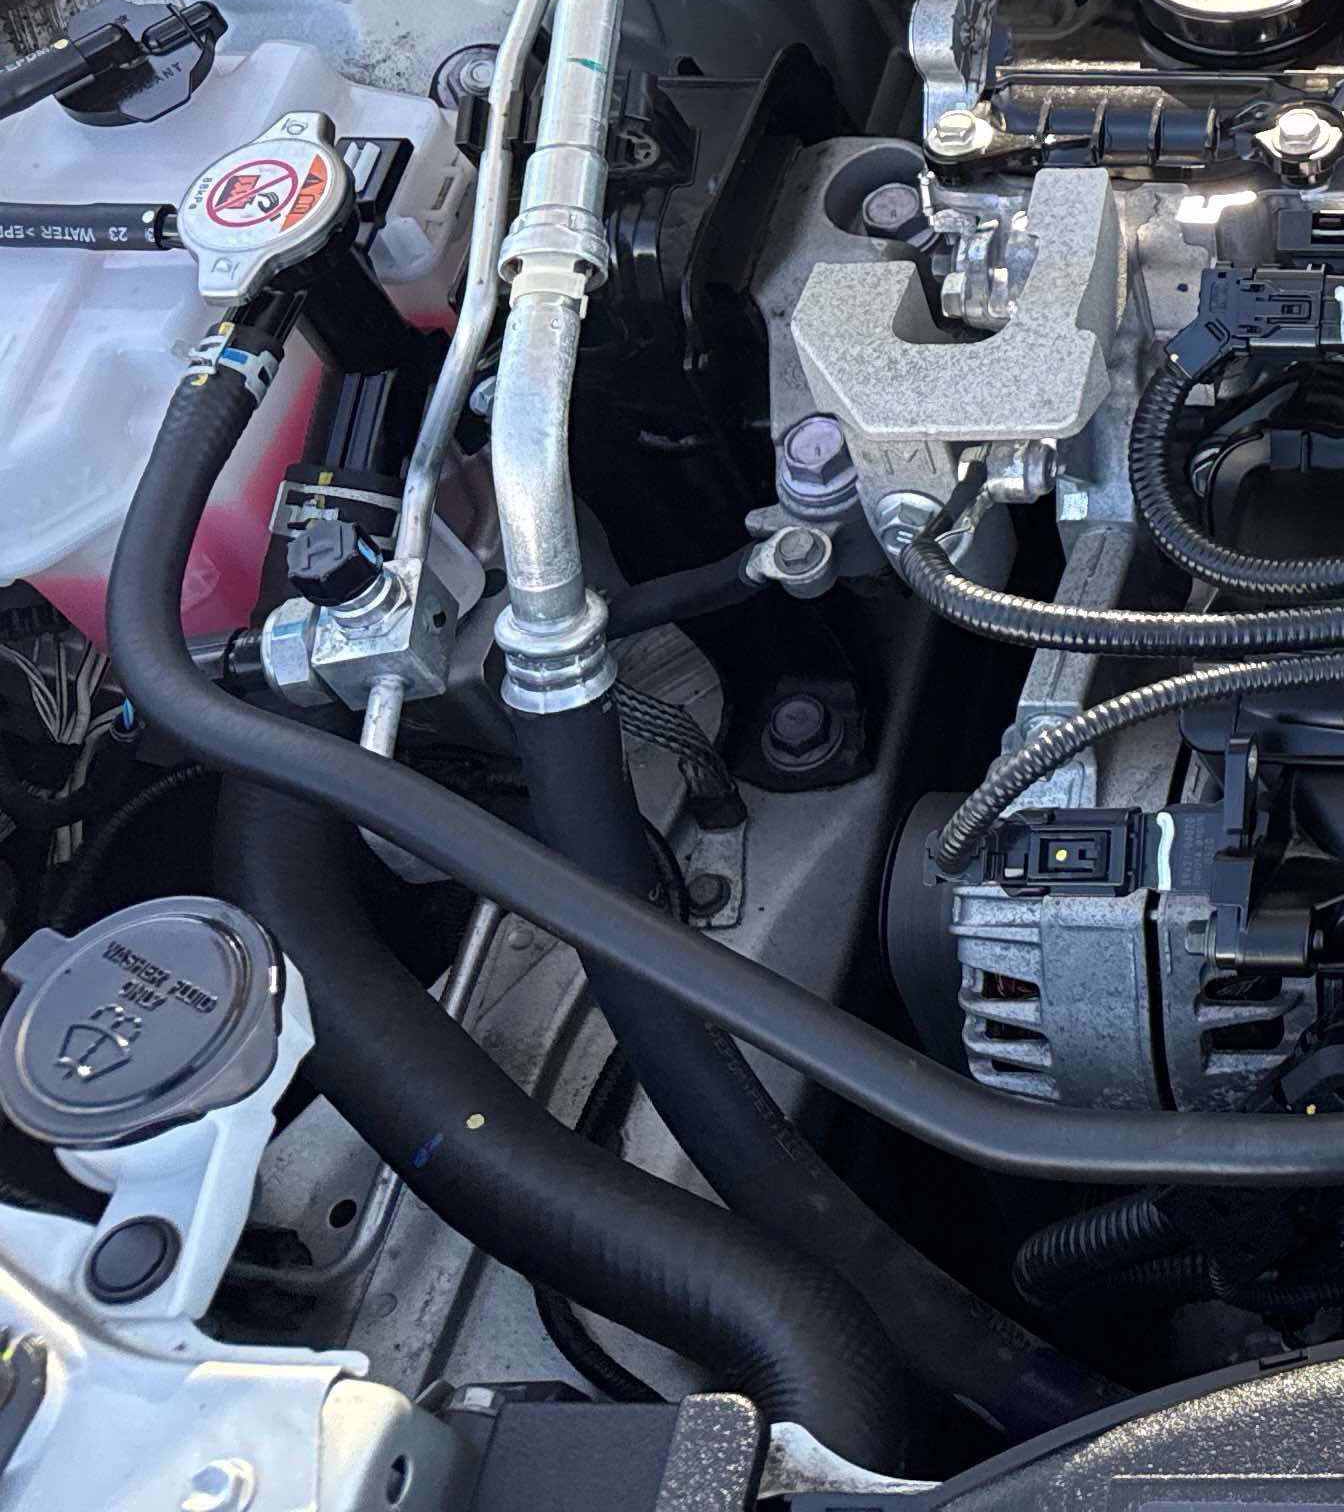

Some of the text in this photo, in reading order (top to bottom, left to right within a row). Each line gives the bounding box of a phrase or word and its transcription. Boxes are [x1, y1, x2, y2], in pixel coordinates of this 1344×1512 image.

[39, 224, 97, 243] WATER
[108, 226, 128, 242] 23
[102, 940, 219, 1014] WASHER FLUID
[119, 979, 168, 1012] ONLY
